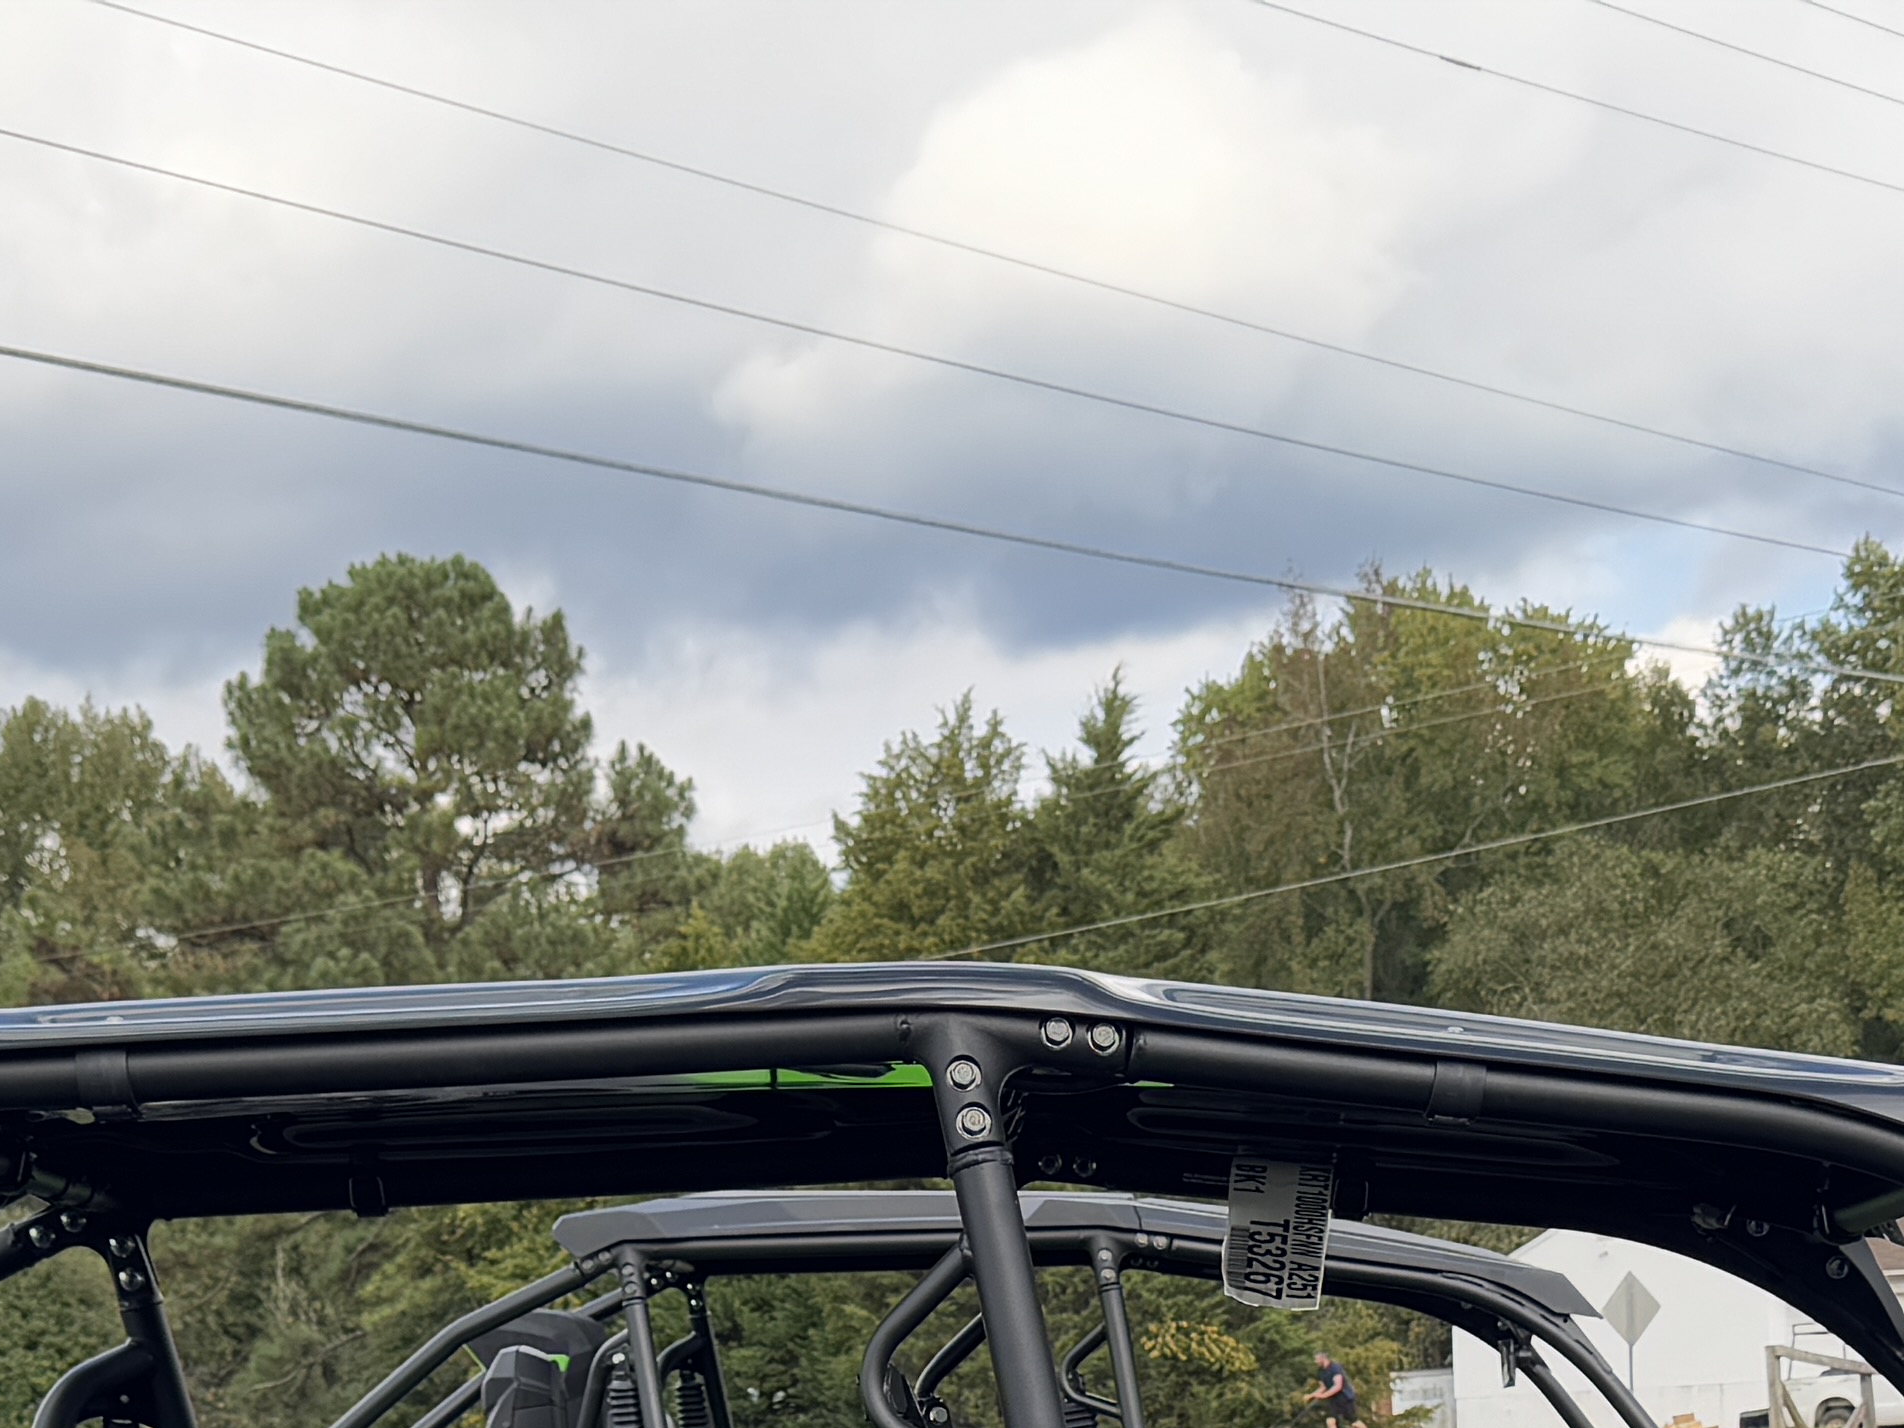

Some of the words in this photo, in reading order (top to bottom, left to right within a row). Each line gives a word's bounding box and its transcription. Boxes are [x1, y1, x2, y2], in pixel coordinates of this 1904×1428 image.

[1233, 1163, 1268, 1194] BK1
[1244, 1218, 1291, 1301] T53267
[1286, 1260, 1321, 1299] A251
